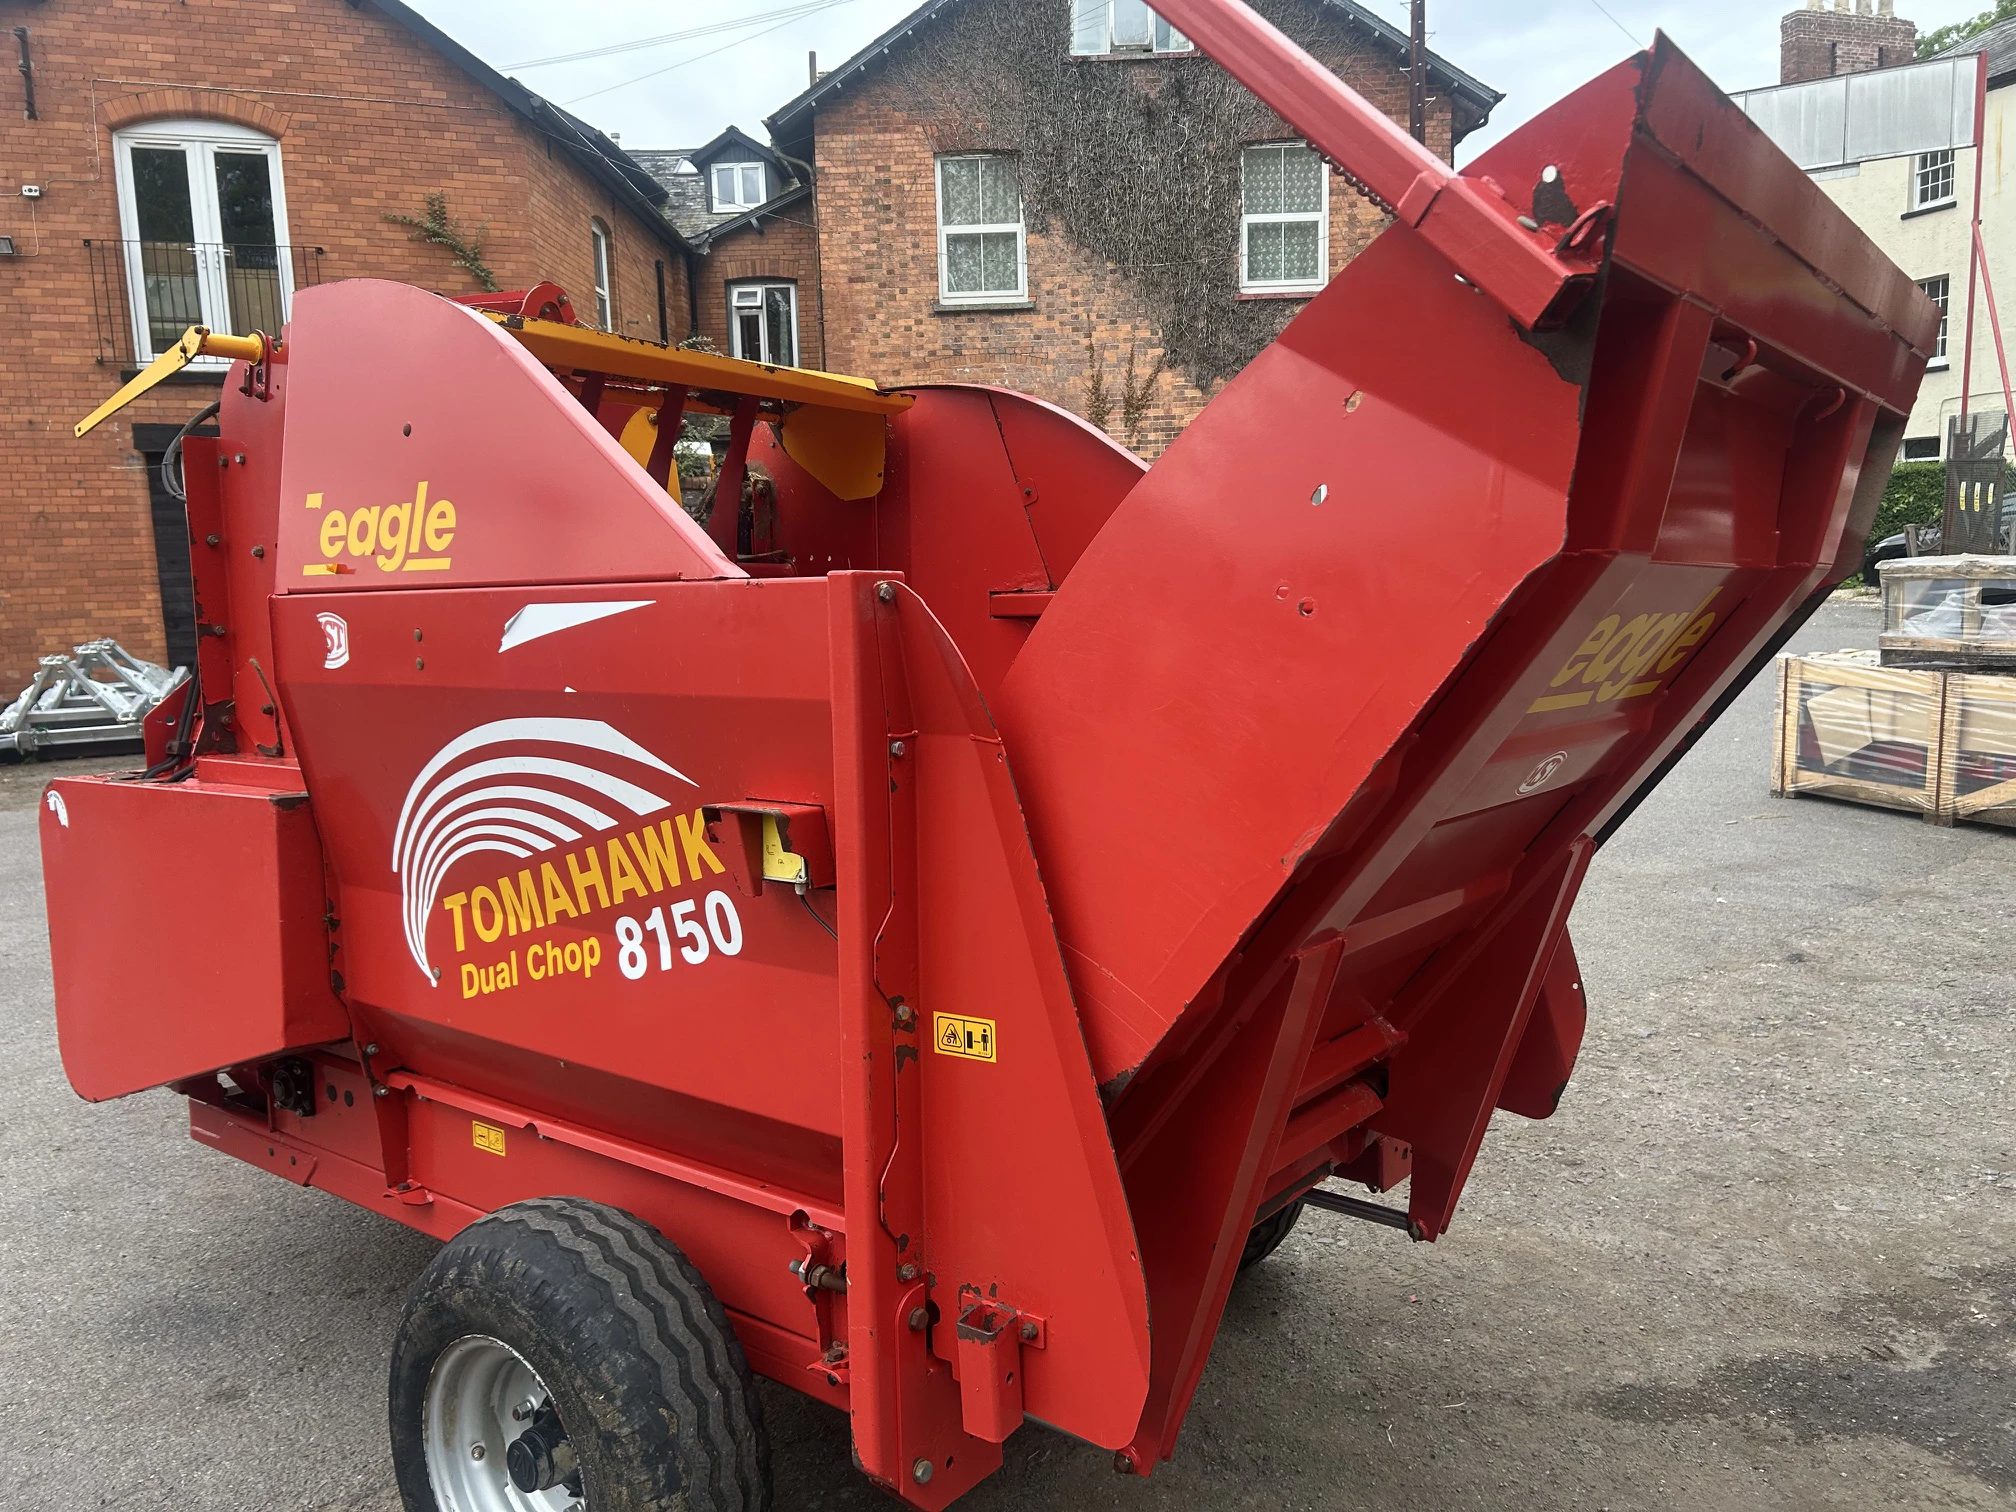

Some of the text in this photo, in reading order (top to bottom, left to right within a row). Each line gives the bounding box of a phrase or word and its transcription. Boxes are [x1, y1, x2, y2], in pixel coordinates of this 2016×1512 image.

[443, 808, 726, 952] TOMAHAWK
[461, 936, 601, 999] Dual Chop
[615, 890, 743, 980] 8150
